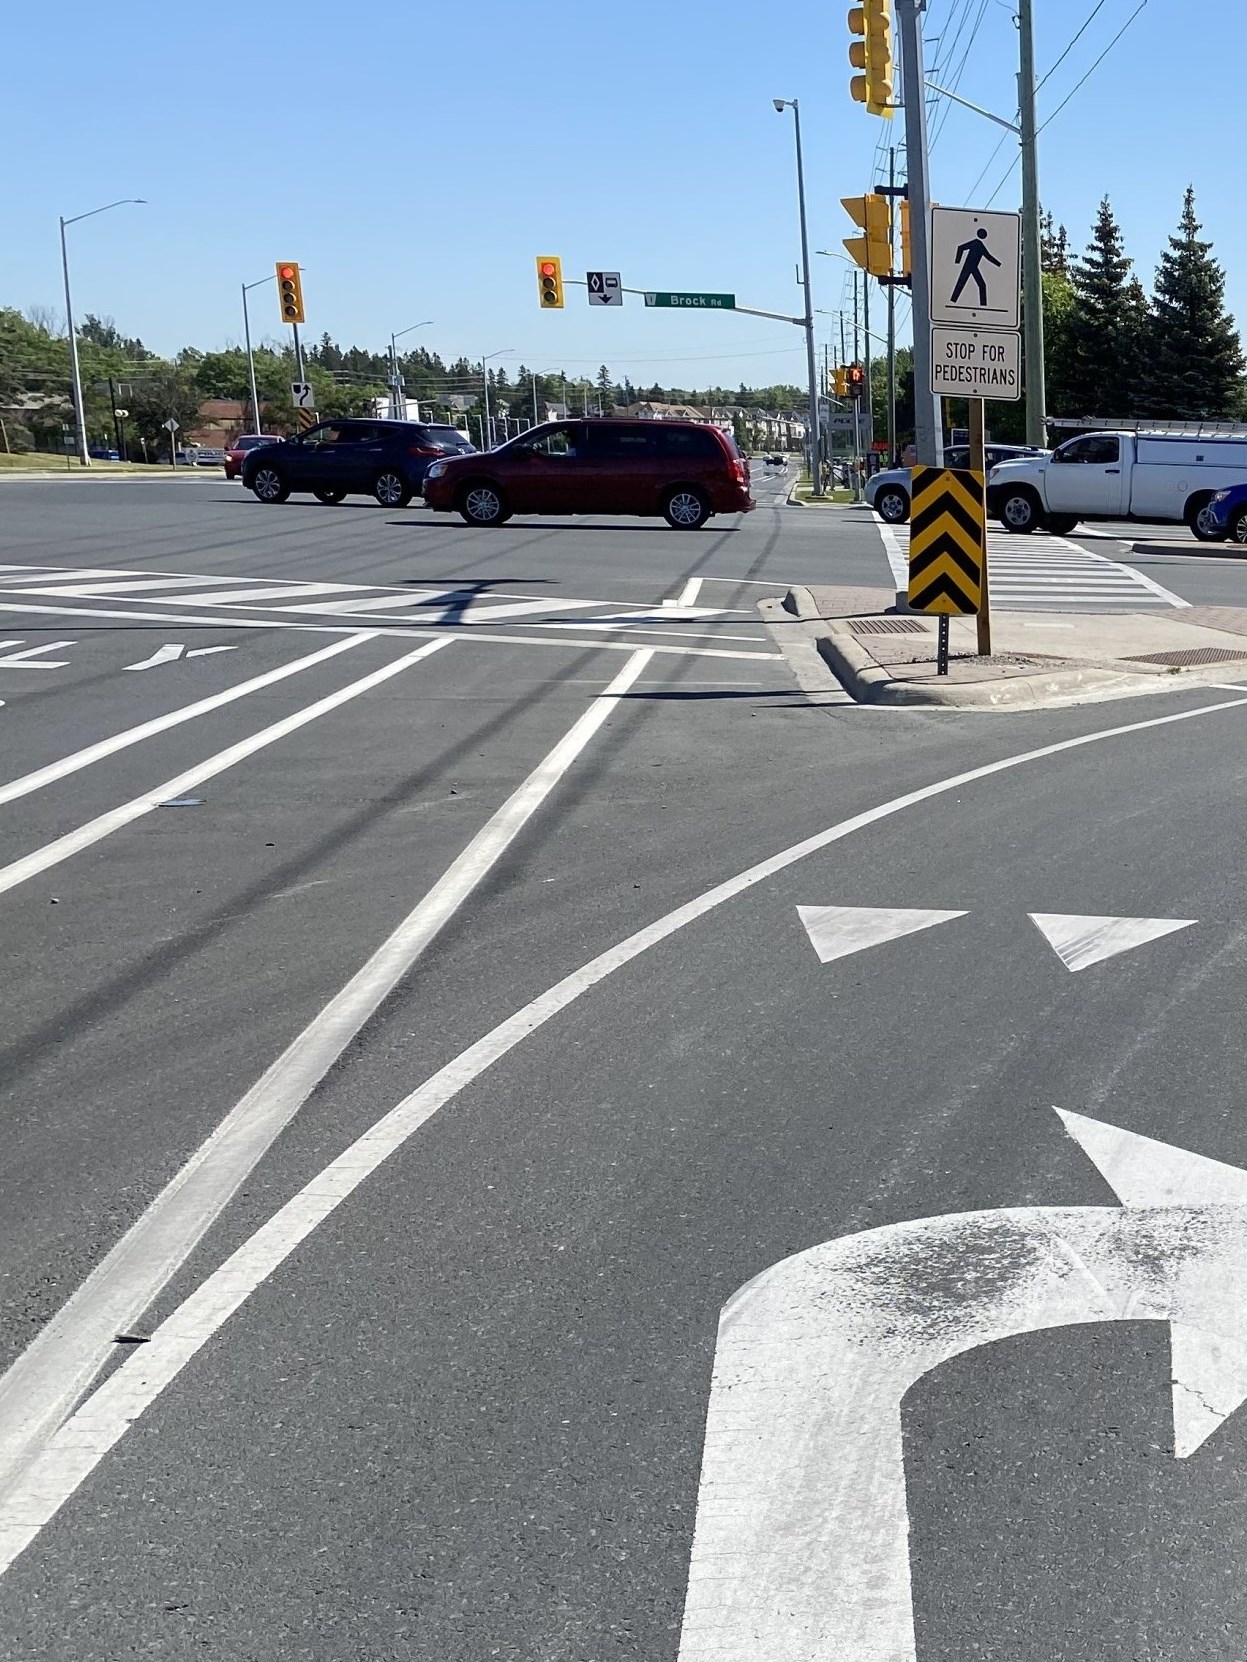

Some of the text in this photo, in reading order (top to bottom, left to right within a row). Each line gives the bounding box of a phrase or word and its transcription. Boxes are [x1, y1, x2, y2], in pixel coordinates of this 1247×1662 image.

[670, 295, 706, 306] Brock
[945, 342, 1005, 362] STOP FOR
[935, 364, 1015, 385] PEDESTRIANS
